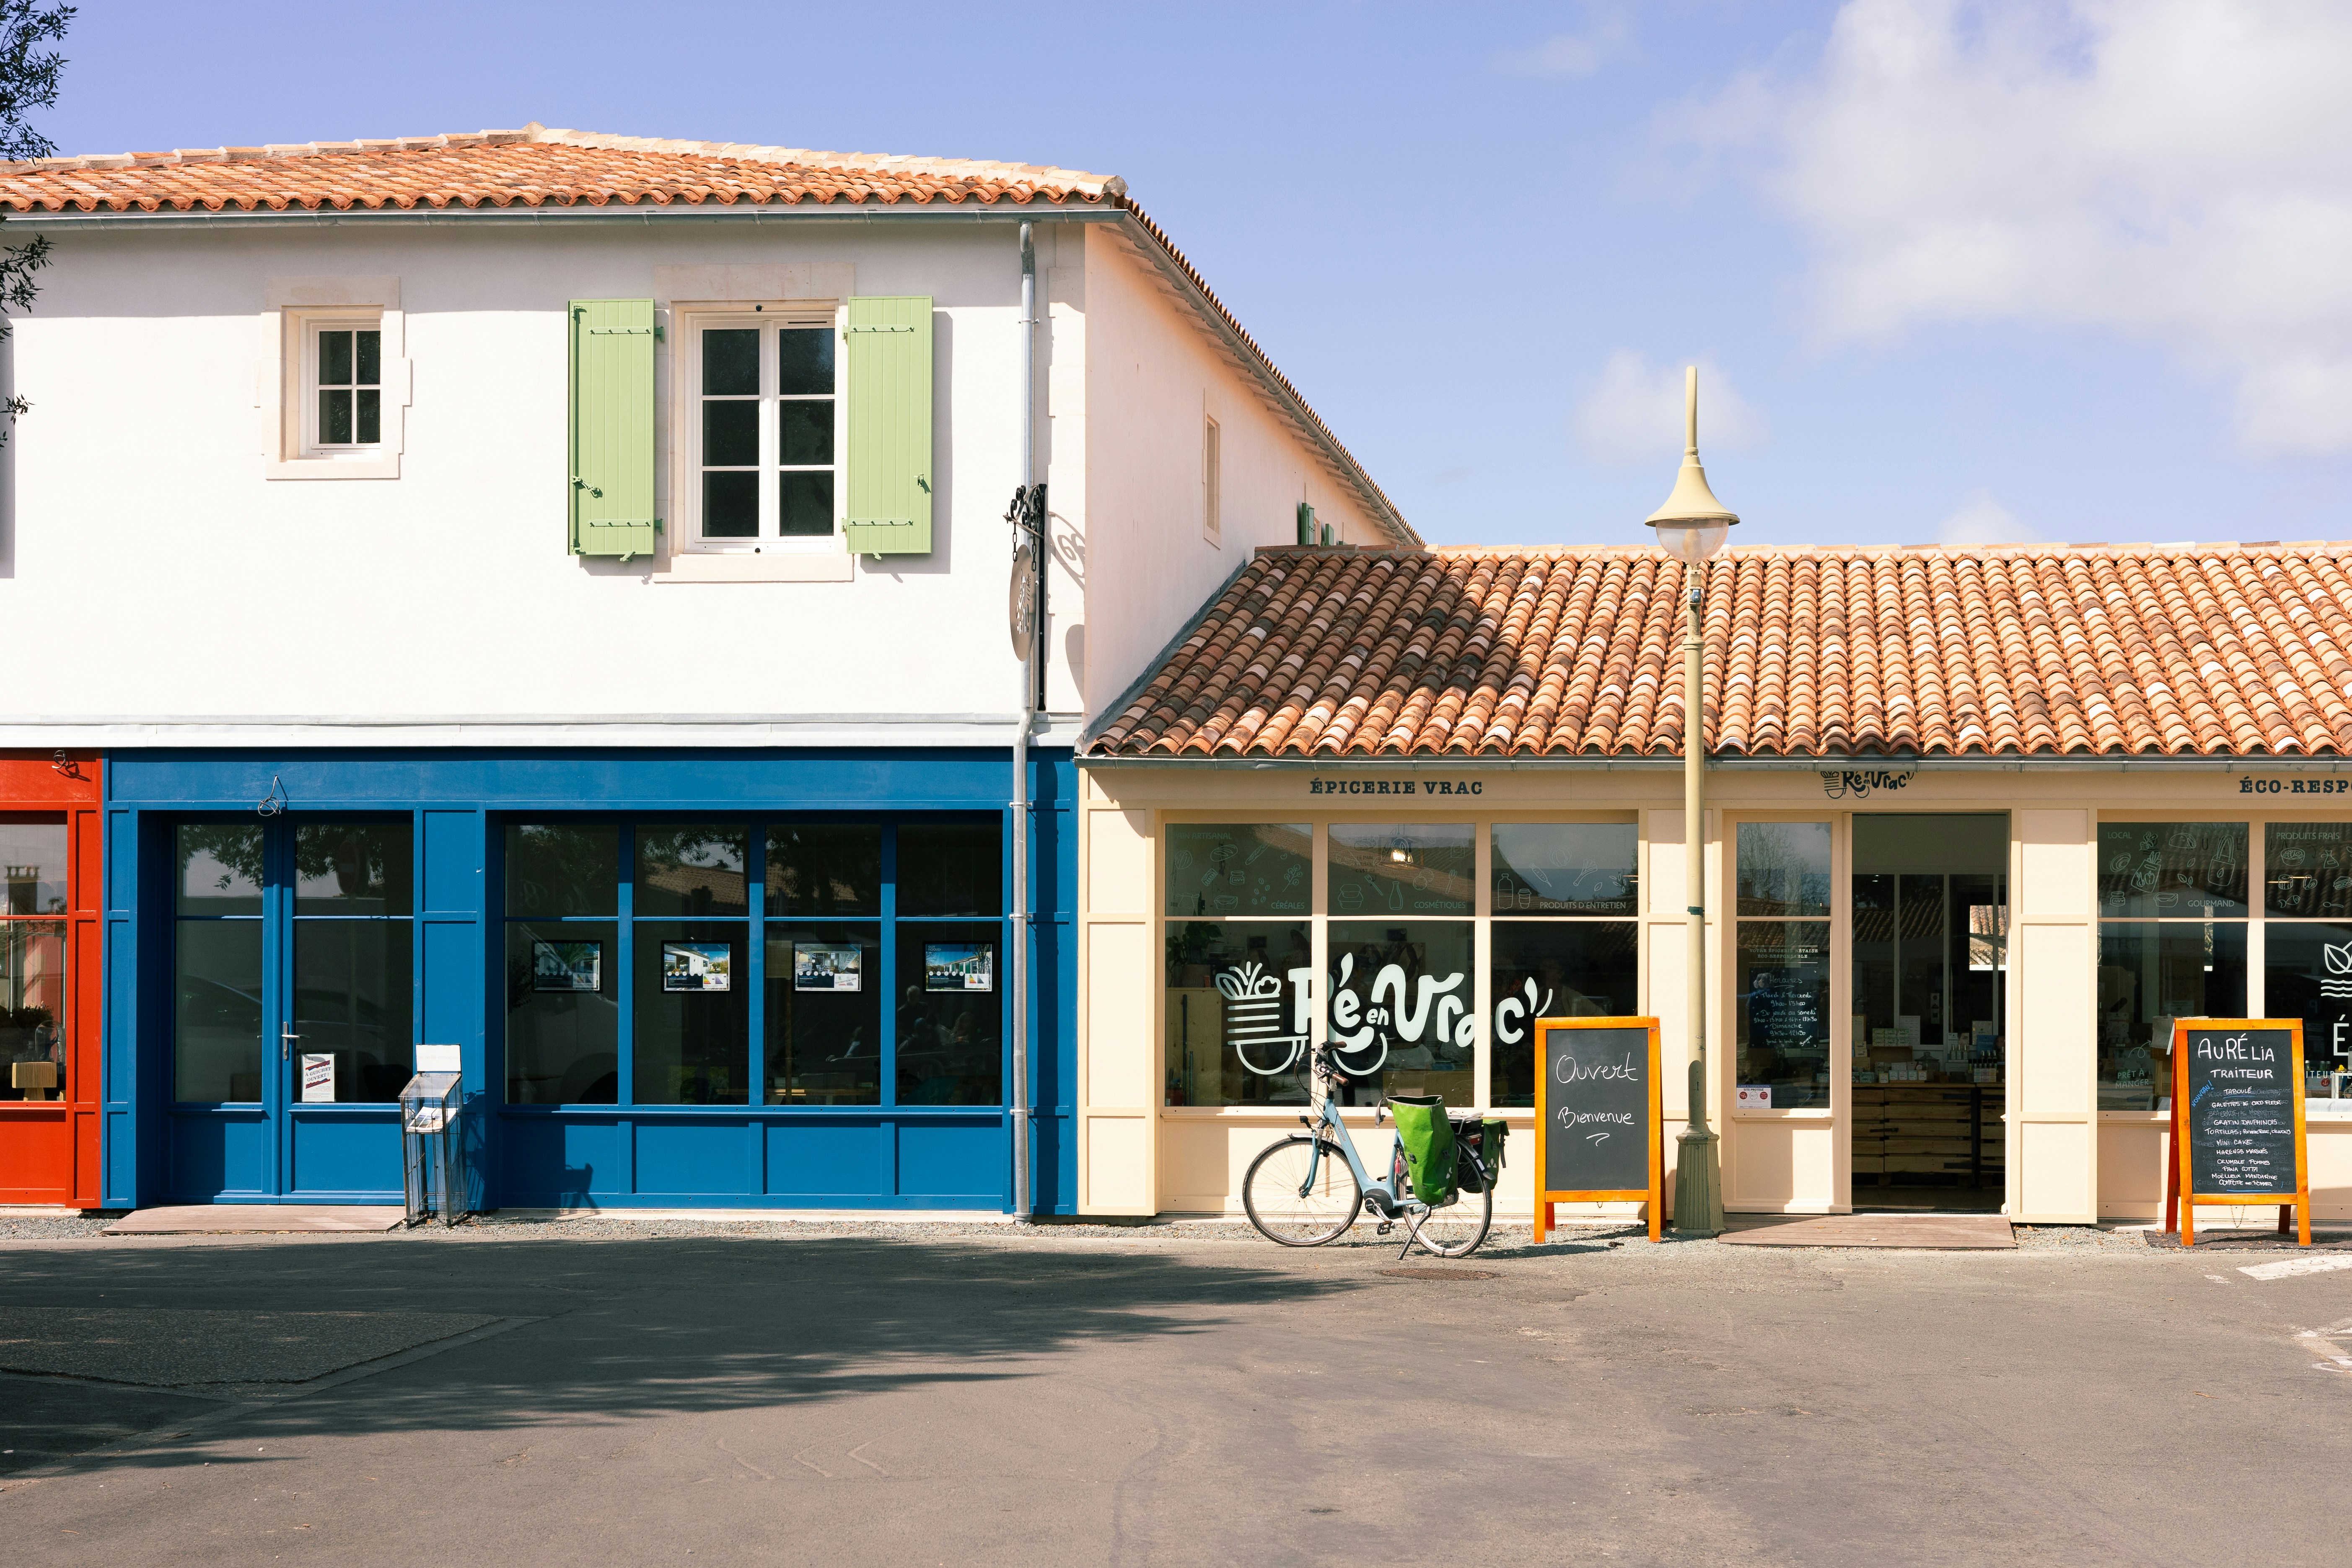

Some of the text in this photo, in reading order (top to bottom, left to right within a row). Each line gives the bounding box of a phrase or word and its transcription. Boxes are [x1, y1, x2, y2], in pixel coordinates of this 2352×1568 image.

[1310, 777, 1483, 795] ÉPICERIE VRAC
[1271, 900, 1305, 909] CÉRÉALES
[1414, 899, 1466, 909] COSMÉTIQUES
[1366, 1006, 1389, 1026] en
[310, 1067, 332, 1076] GUICHET
[1556, 1052, 1638, 1084] Ouvert
[2210, 1067, 2274, 1079] TRAITEUR
[307, 1073, 327, 1082] OUVERT
[2117, 1068, 2145, 1079] PRÊT À
[2115, 1079, 2149, 1089] MANGER
[2223, 1086, 2252, 1095] TABOULÉ
[1557, 1106, 1635, 1129] Bienvenue
